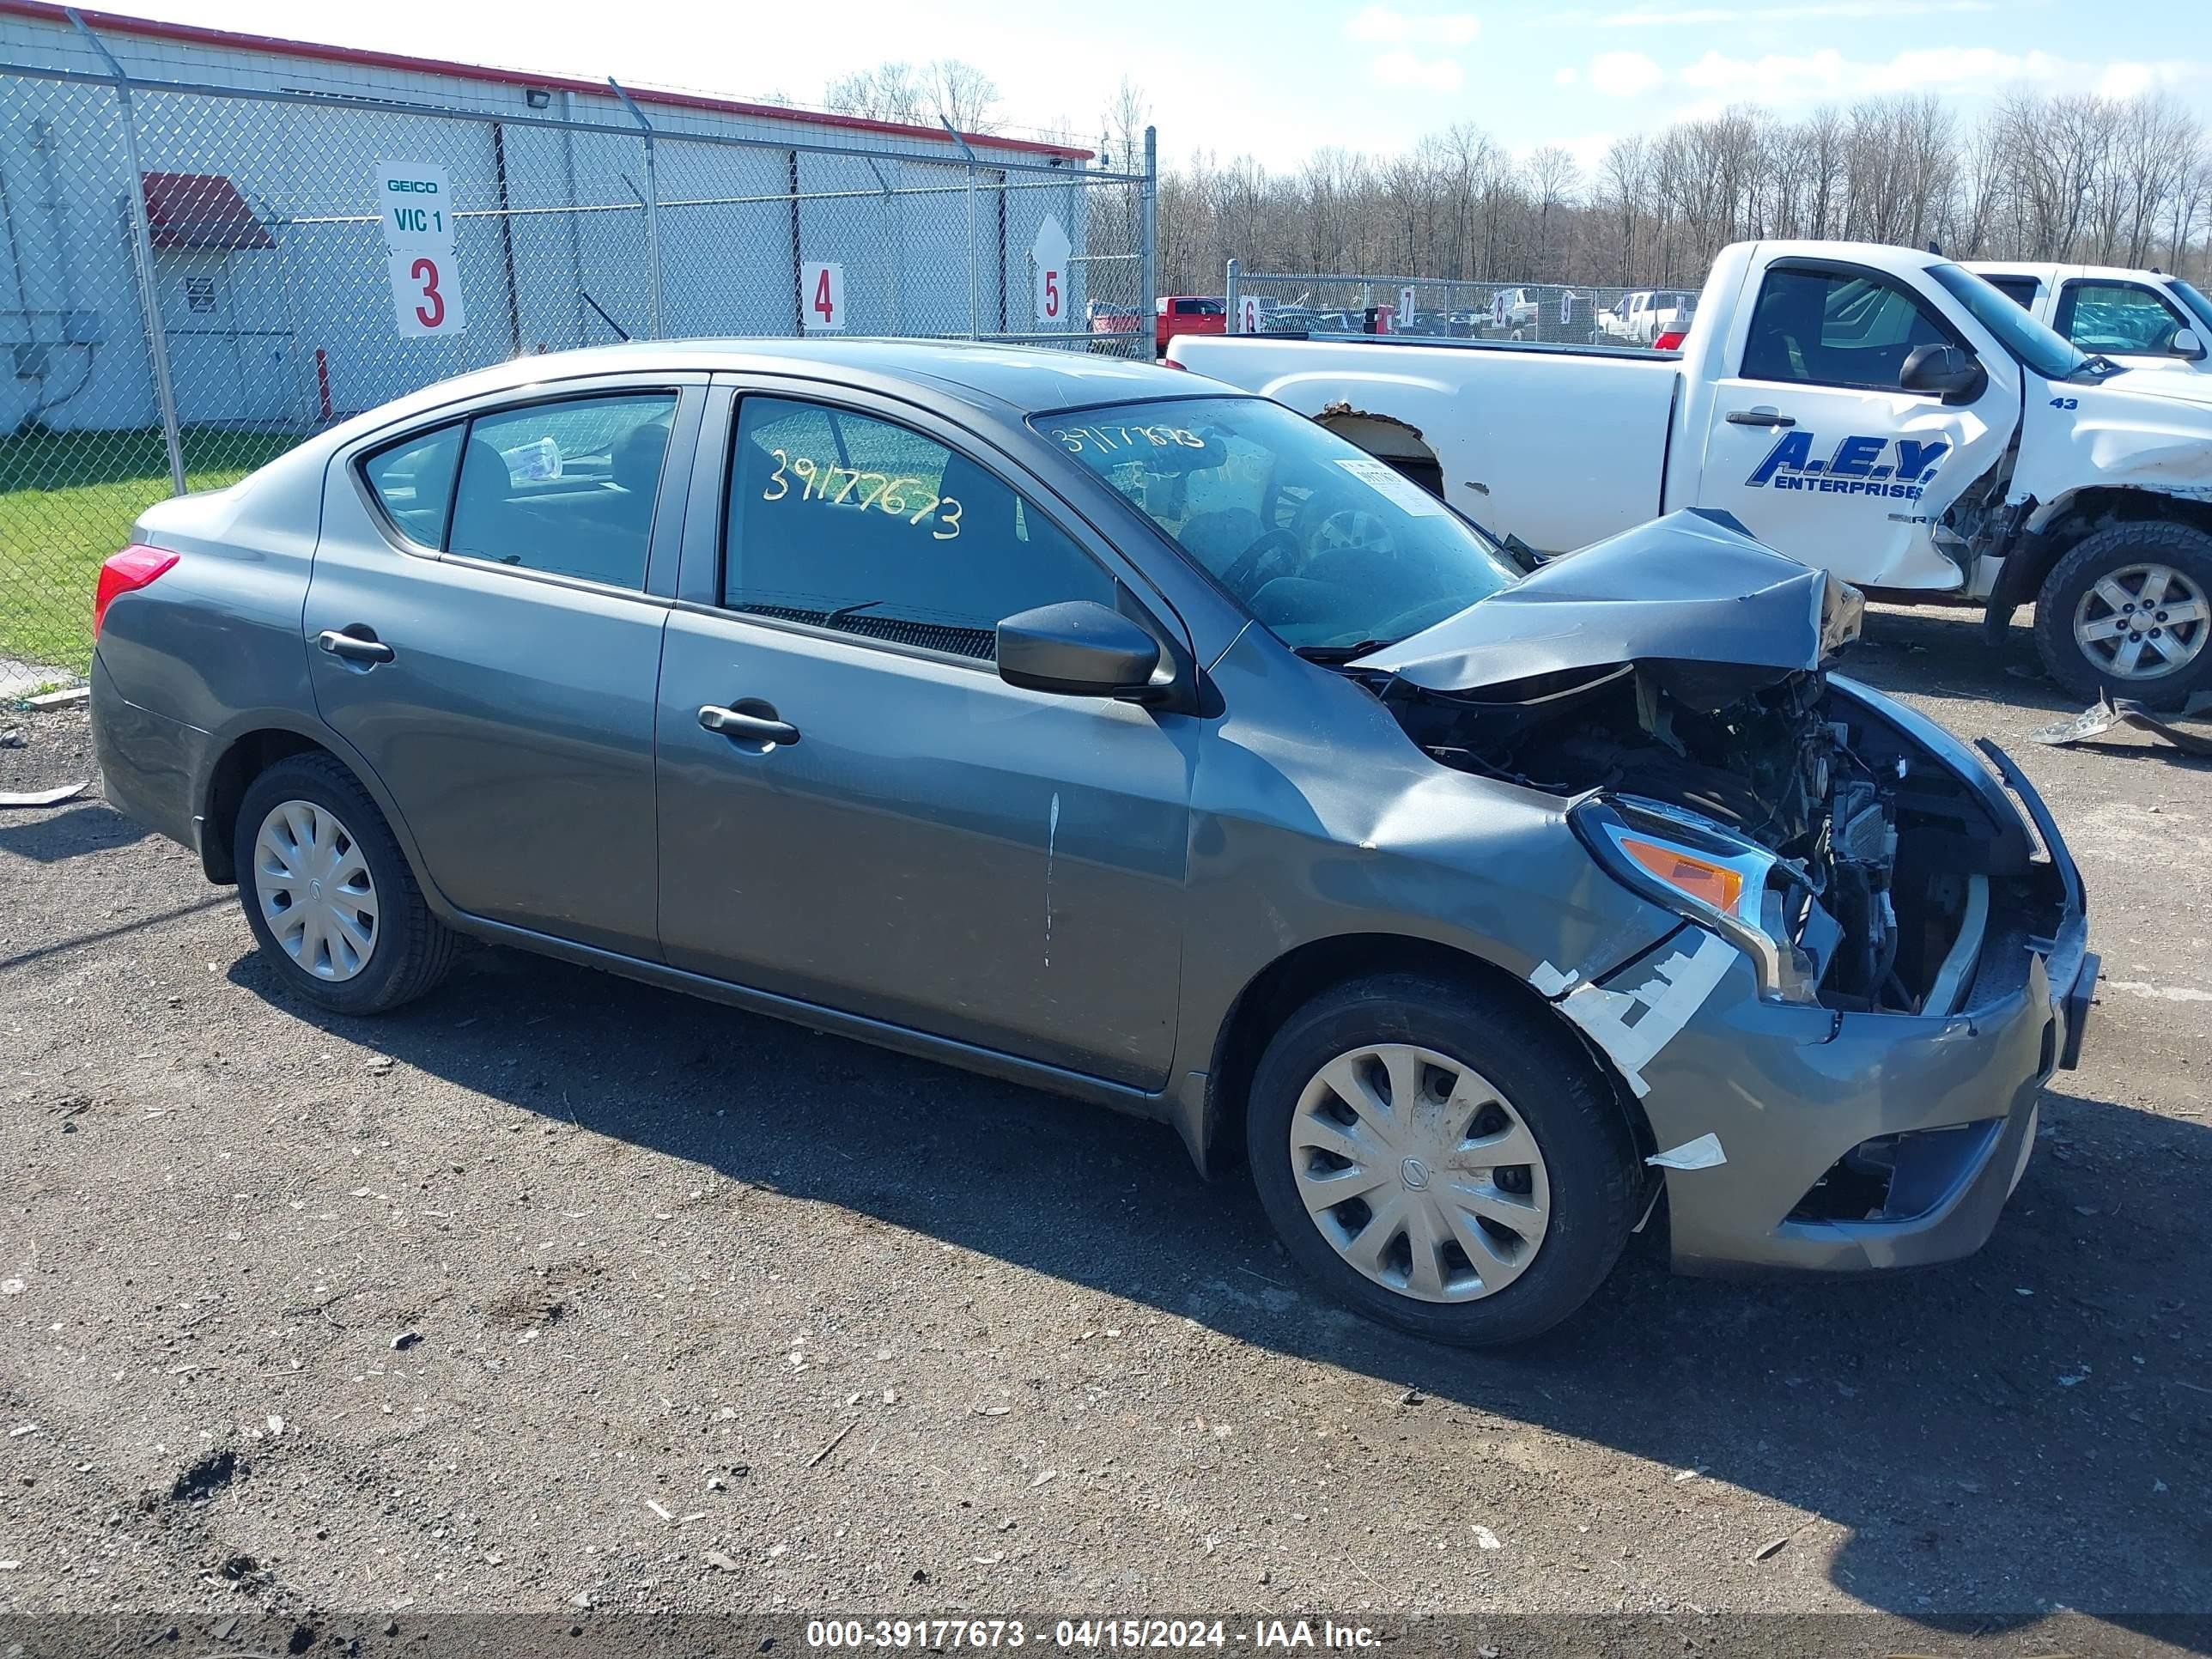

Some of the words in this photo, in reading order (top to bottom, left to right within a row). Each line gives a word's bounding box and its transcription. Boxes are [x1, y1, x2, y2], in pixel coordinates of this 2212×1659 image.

[387, 179, 440, 194] GEICO
[394, 208, 427, 232] VIC
[433, 210, 442, 232] 1
[411, 258, 444, 327] 3
[815, 269, 833, 323] 4
[1046, 271, 1058, 317] 5
[1405, 292, 1411, 322] 7
[1246, 301, 1255, 332] 6
[1497, 295, 1503, 324] 8
[2049, 398, 2078, 410] 43
[763, 449, 963, 539] 39177673
[1774, 476, 1923, 500] ENTERPRISES
